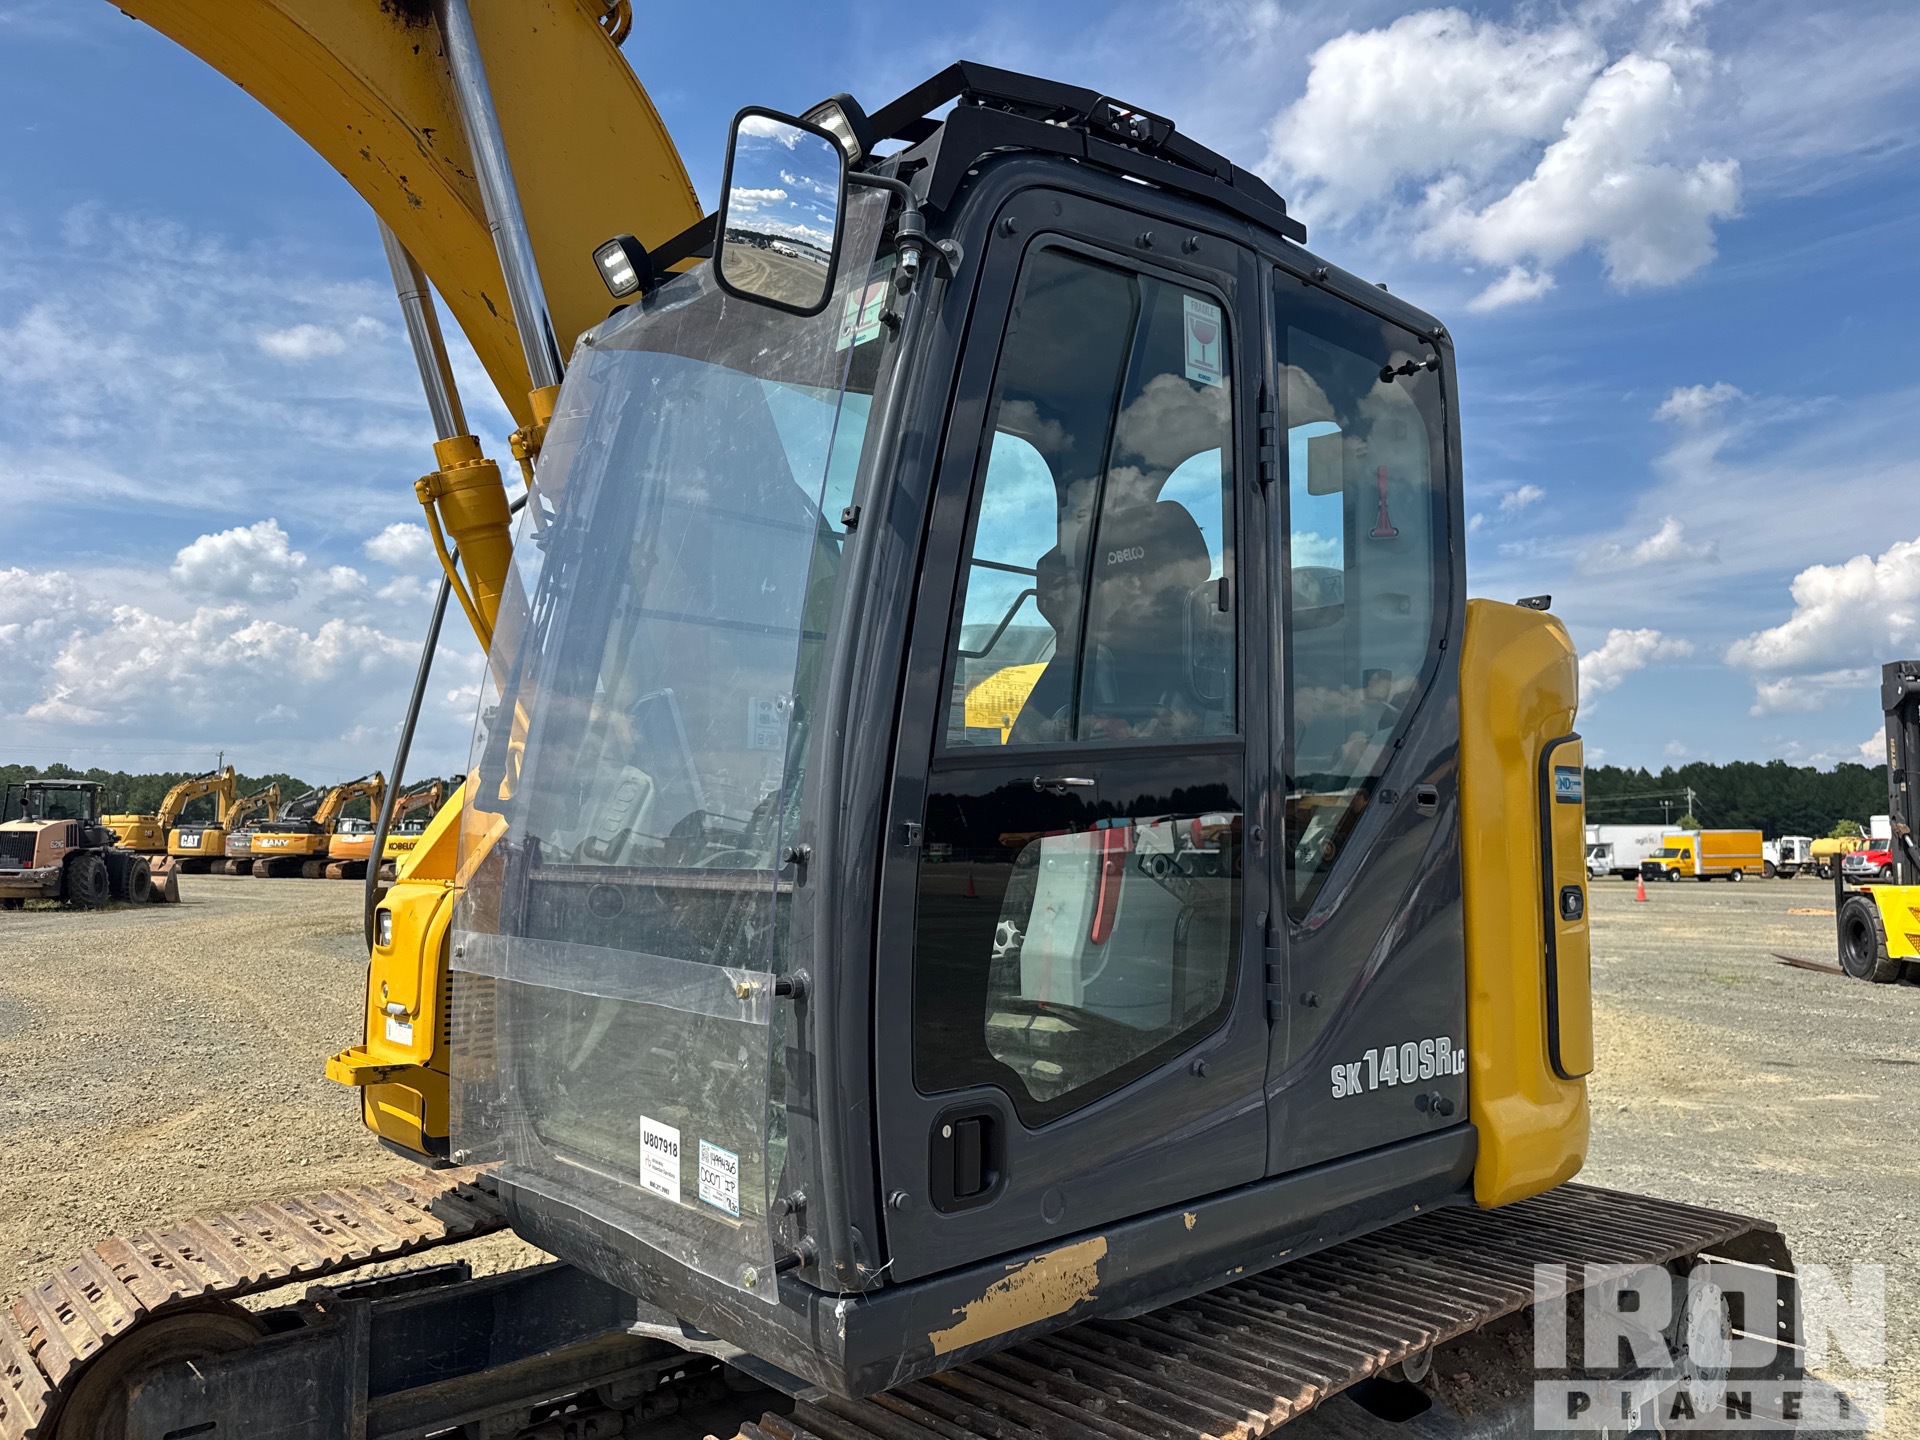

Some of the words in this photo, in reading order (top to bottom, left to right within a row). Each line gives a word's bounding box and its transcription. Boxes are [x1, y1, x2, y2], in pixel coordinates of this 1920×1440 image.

[1191, 300, 1214, 318] FRAGILE
[1107, 546, 1144, 566] OBELCO
[181, 834, 200, 848] CAT
[261, 839, 290, 848] SANY
[643, 1130, 677, 1157] U807918
